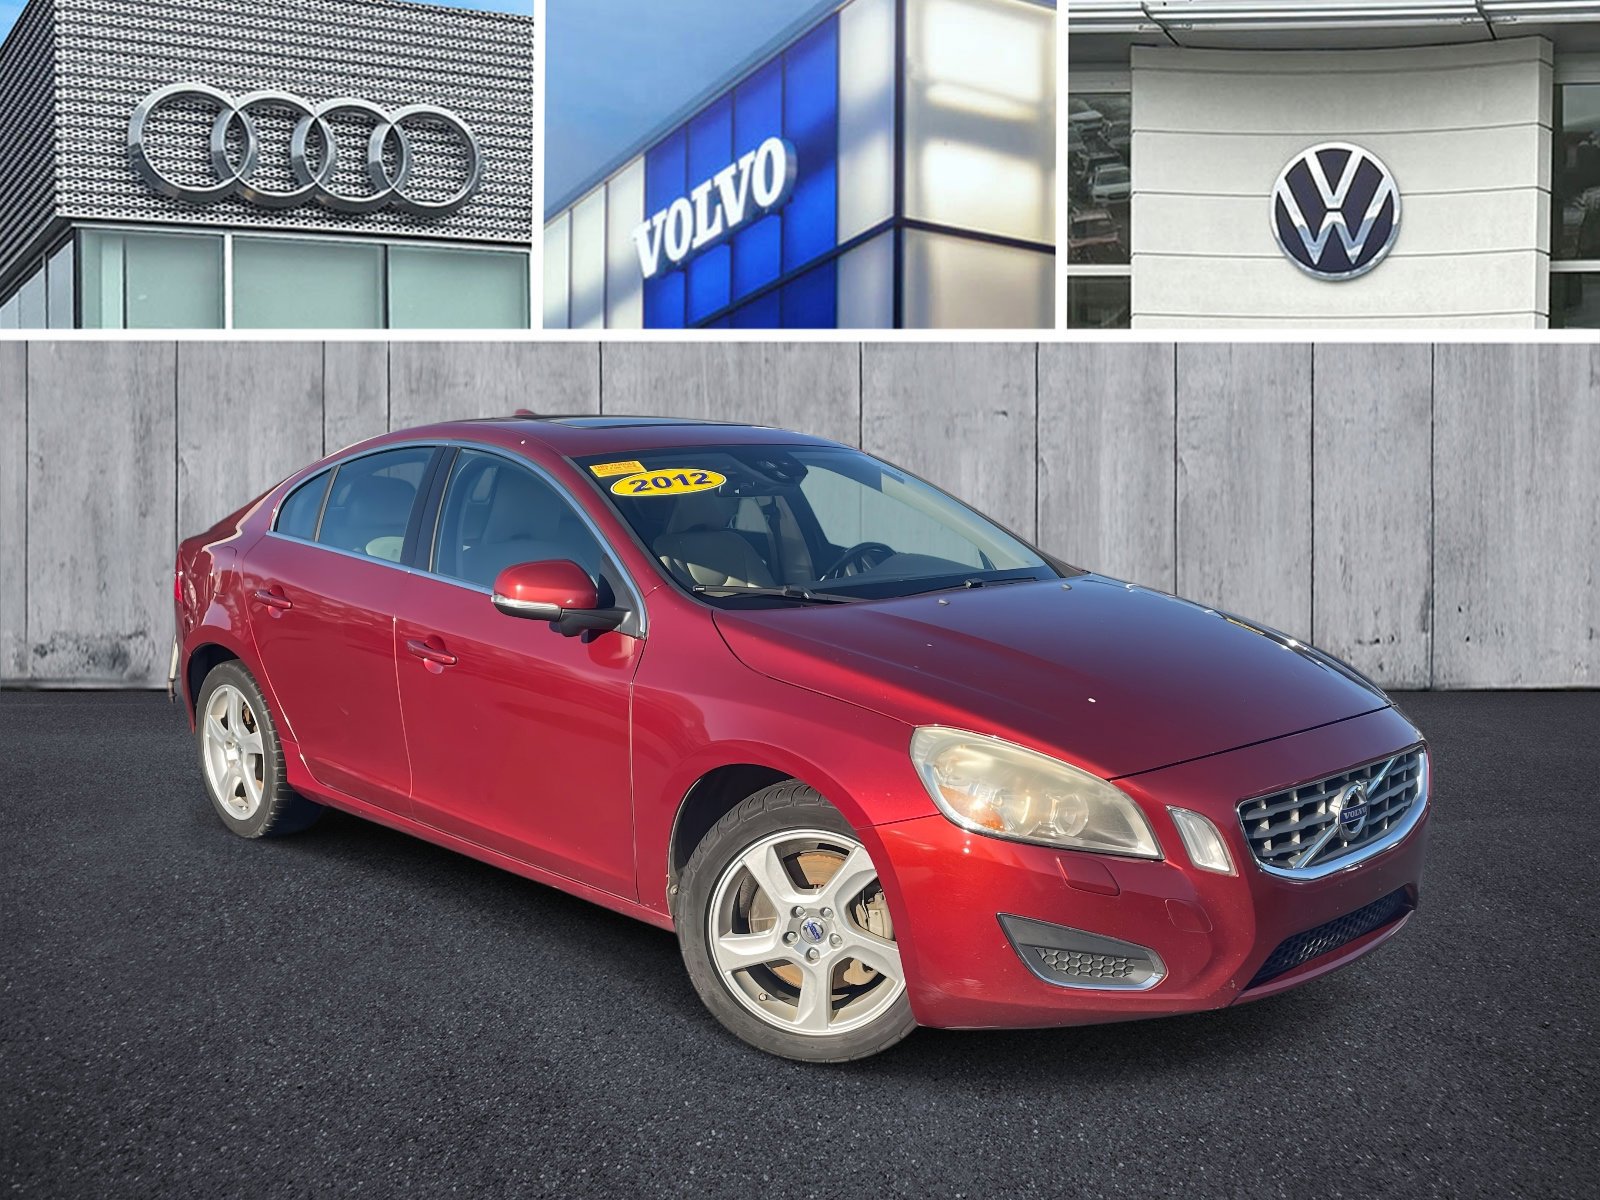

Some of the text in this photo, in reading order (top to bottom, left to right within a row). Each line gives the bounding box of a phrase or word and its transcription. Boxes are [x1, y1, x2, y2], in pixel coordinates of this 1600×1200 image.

[633, 137, 787, 279] VOLVO
[629, 472, 712, 492] 2012
[1343, 806, 1367, 819] VOLVO
